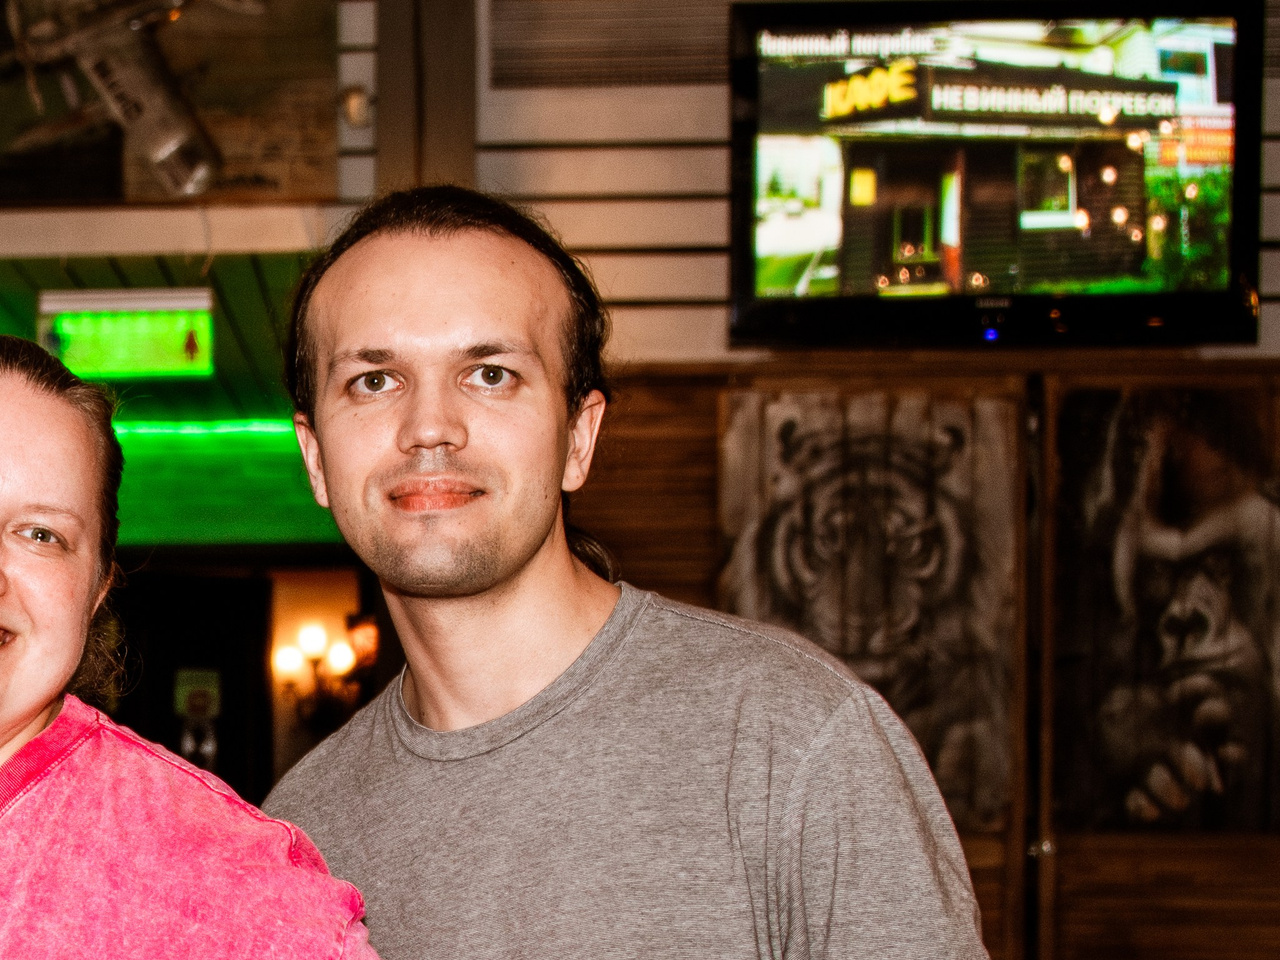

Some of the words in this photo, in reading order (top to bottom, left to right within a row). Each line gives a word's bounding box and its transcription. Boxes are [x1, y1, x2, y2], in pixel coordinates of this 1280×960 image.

[823, 57, 917, 119] КАФЕ
[931, 84, 1067, 113] НЕВИННЫЙ
[1069, 89, 1176, 116] ПОГРЕБОК
